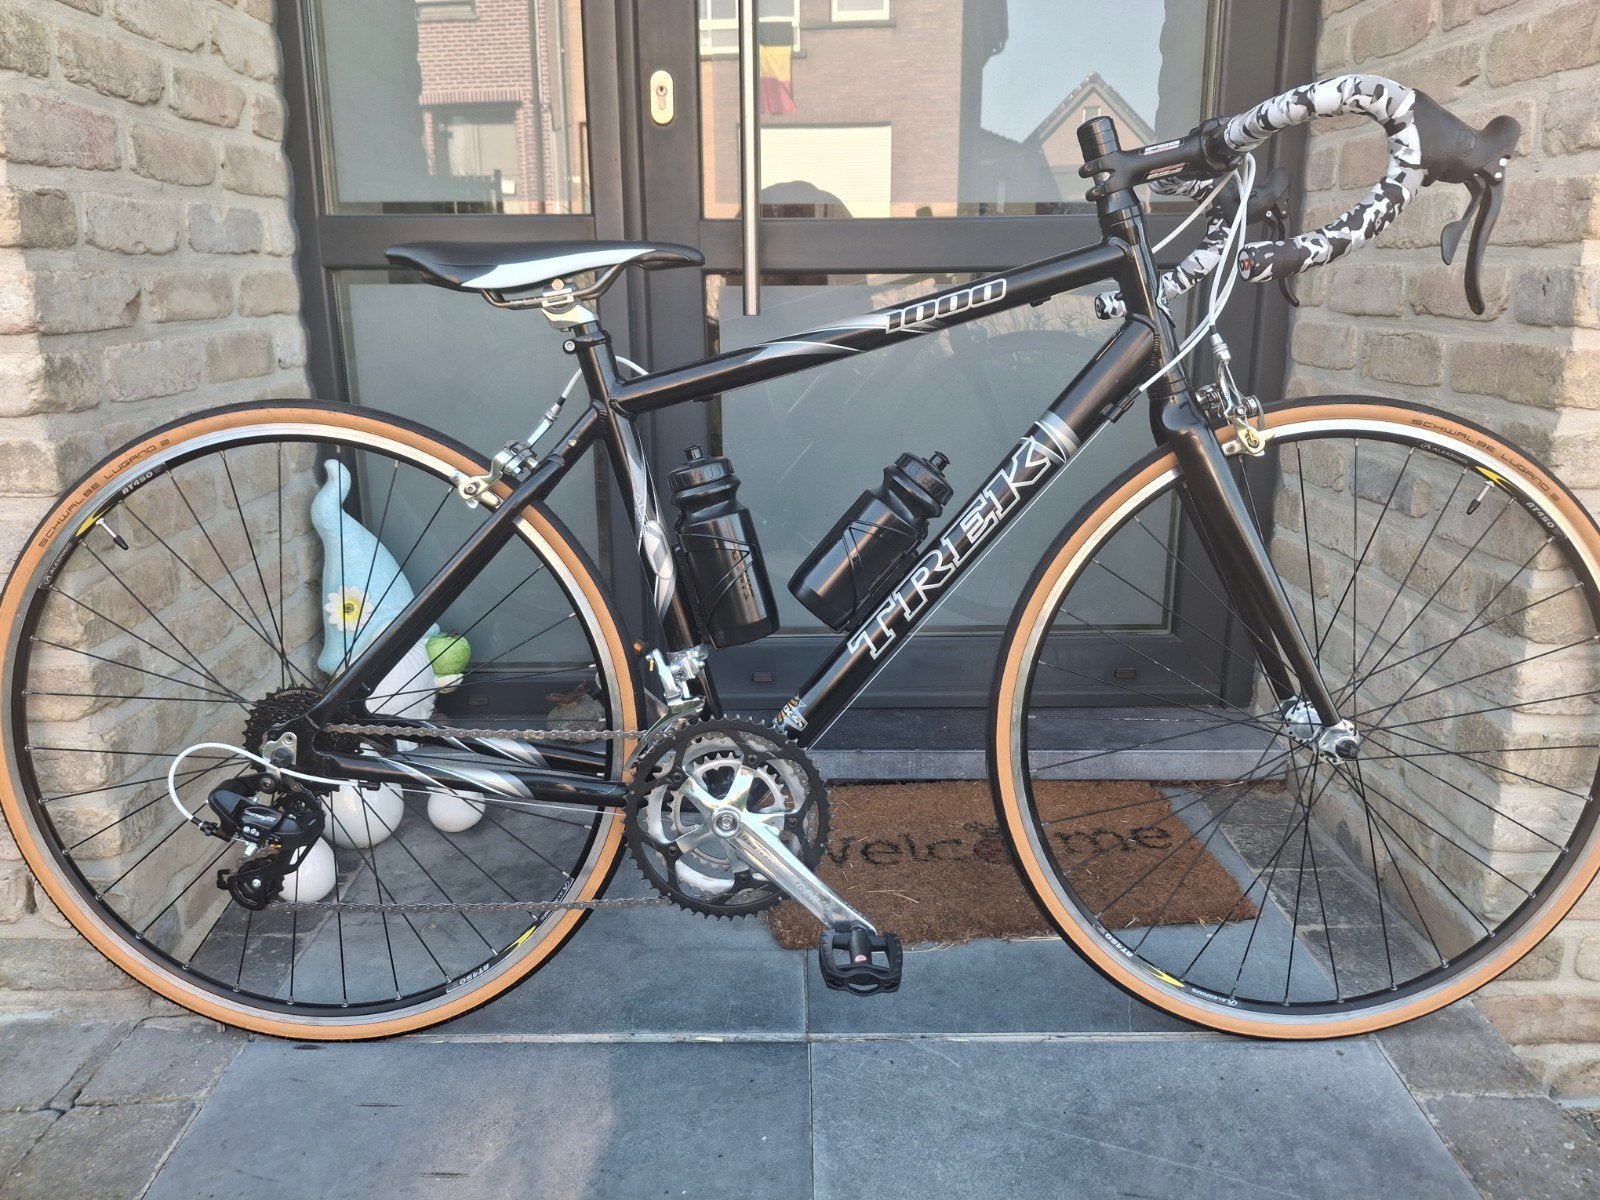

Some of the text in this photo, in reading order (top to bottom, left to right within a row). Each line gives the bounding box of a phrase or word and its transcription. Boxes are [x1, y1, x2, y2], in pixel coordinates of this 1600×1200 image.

[885, 278, 1007, 333] 1000
[38, 482, 100, 548] SCHWALBE
[104, 445, 156, 479] LUGANO
[1410, 417, 1560, 503] SCHWALBE LUGANO 2
[846, 436, 1052, 660] TREK
